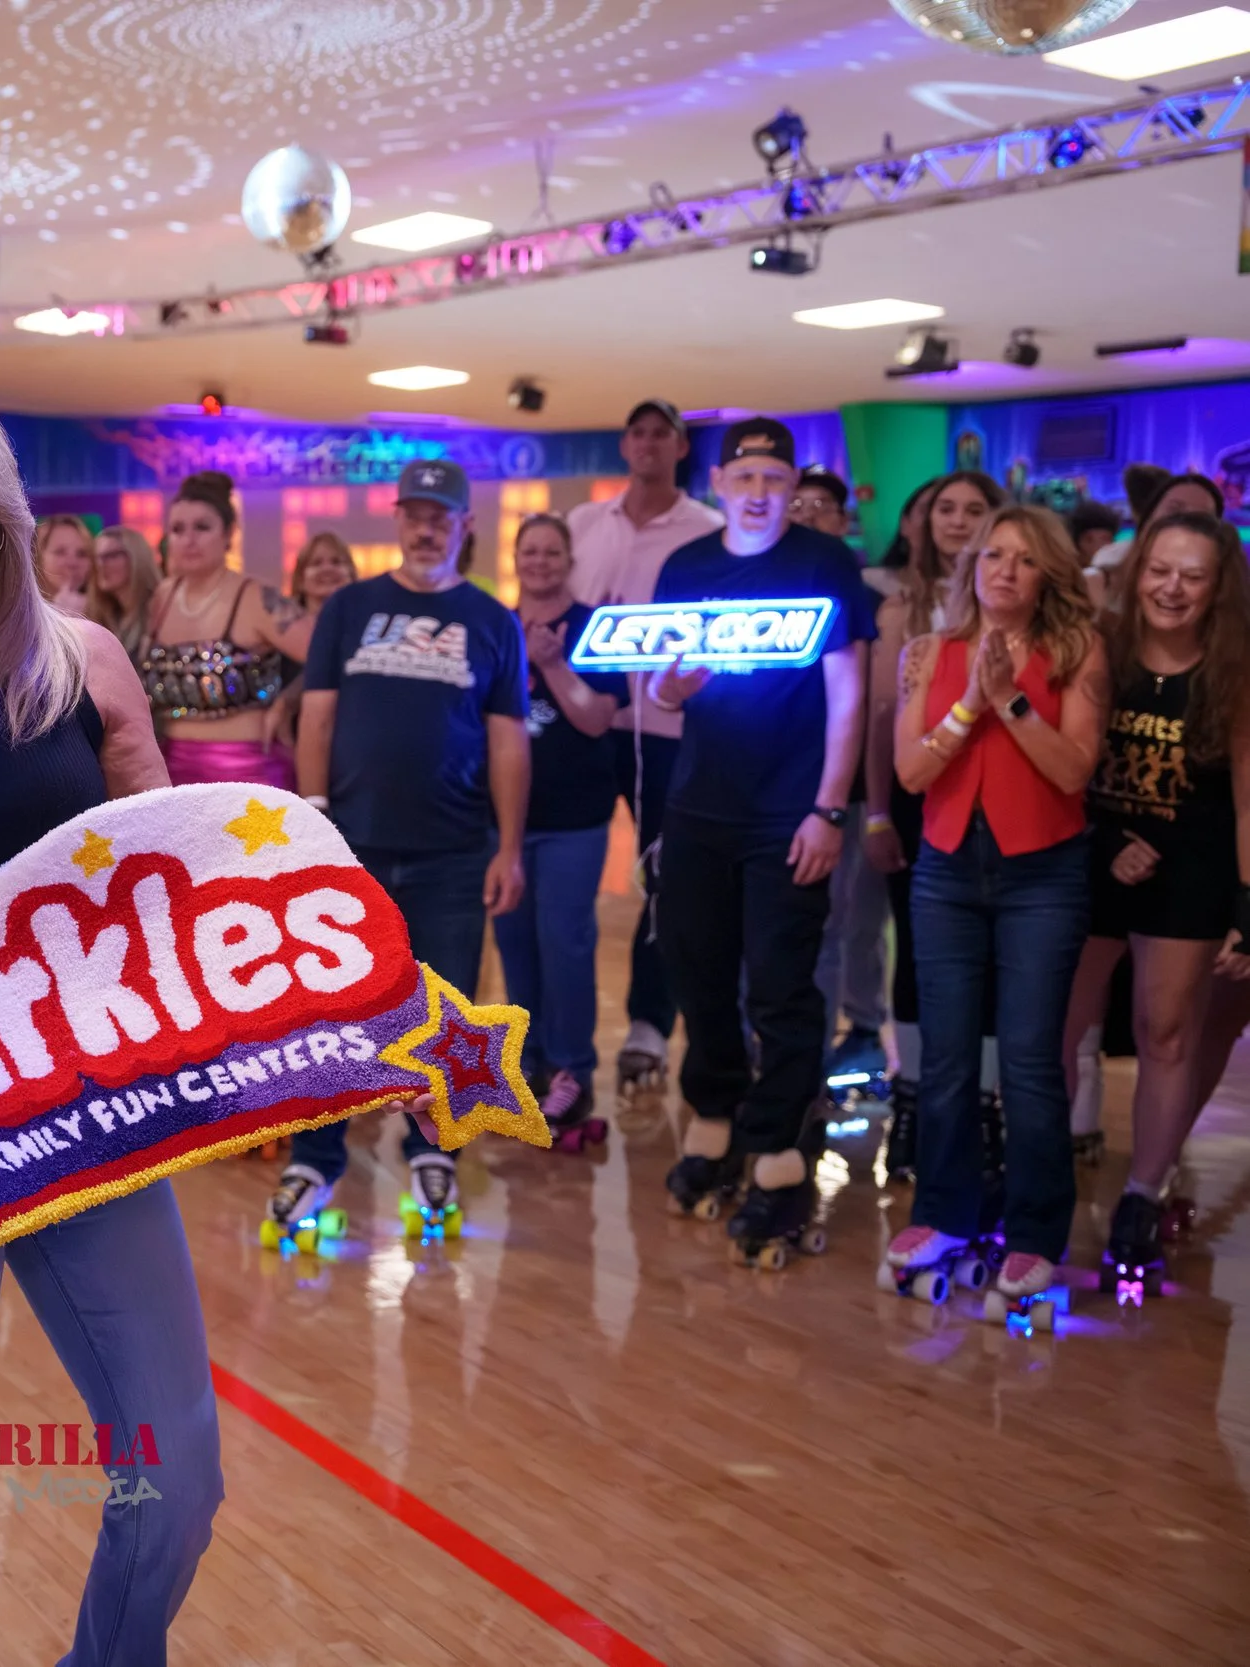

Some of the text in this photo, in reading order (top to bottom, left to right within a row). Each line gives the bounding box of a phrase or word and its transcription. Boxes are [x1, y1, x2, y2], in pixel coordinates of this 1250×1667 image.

[361, 612, 468, 661] USA
[589, 610, 703, 655] LET'S
[87, 1082, 177, 1134] FUN
[176, 1025, 378, 1102] CENTERS
